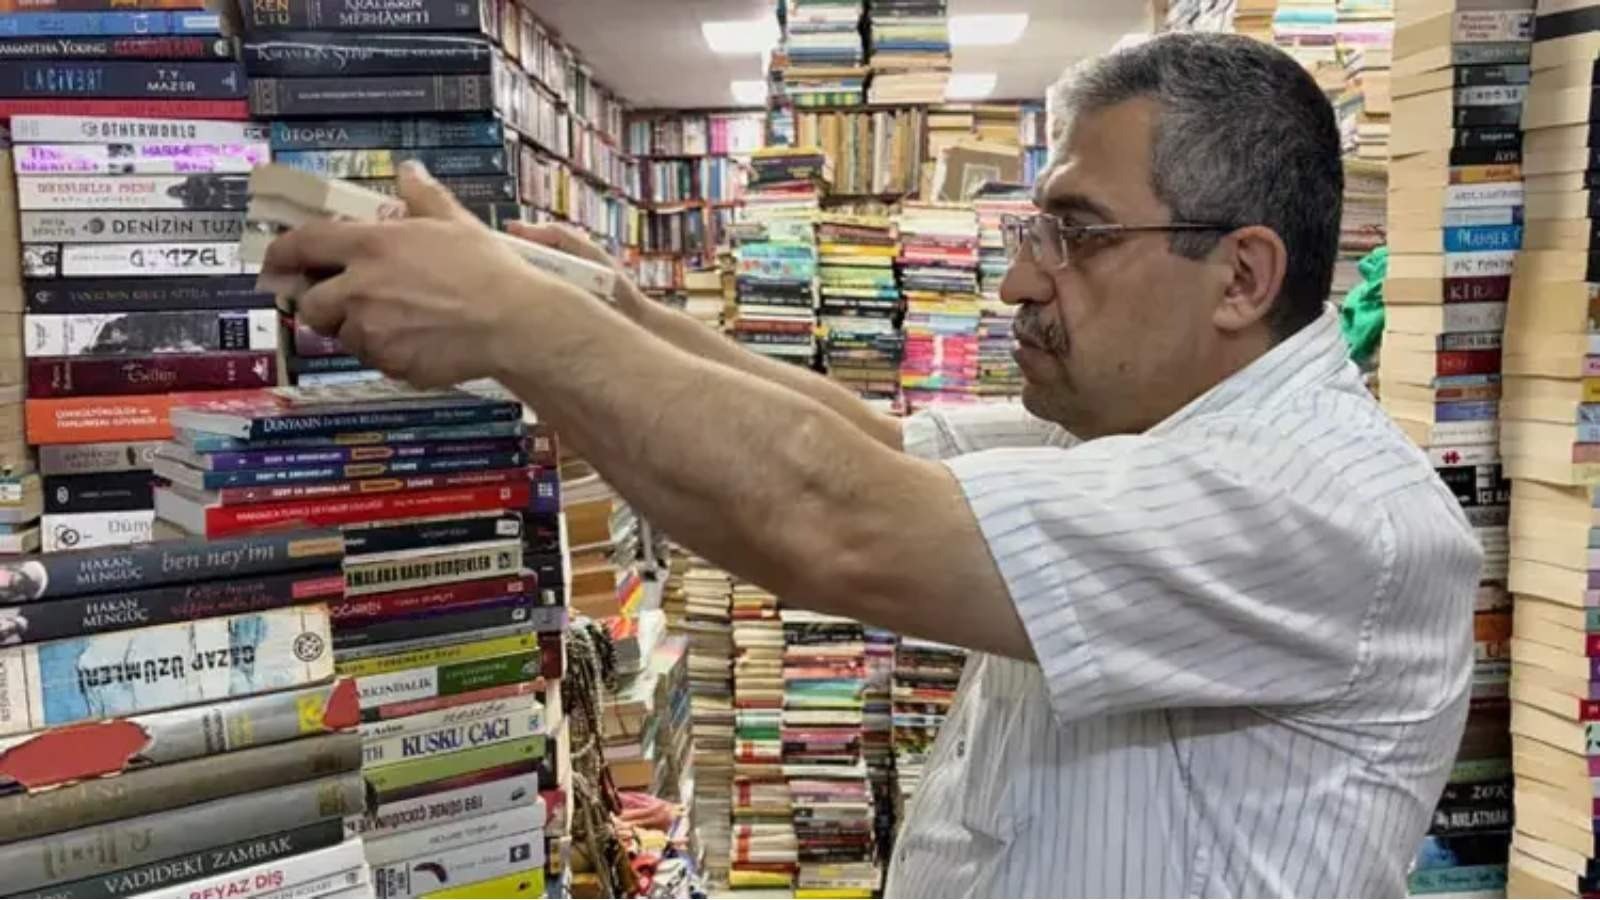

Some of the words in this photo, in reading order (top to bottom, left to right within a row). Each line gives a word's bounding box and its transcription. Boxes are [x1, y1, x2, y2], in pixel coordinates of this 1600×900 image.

[101, 123, 196, 138] OTHERWORLD
[112, 216, 193, 235] DENİZİN
[80, 556, 133, 570] HAKAN
[162, 552, 199, 572] ben
[87, 598, 139, 614] HAKAN
[212, 835, 292, 869] ZAMBAK
